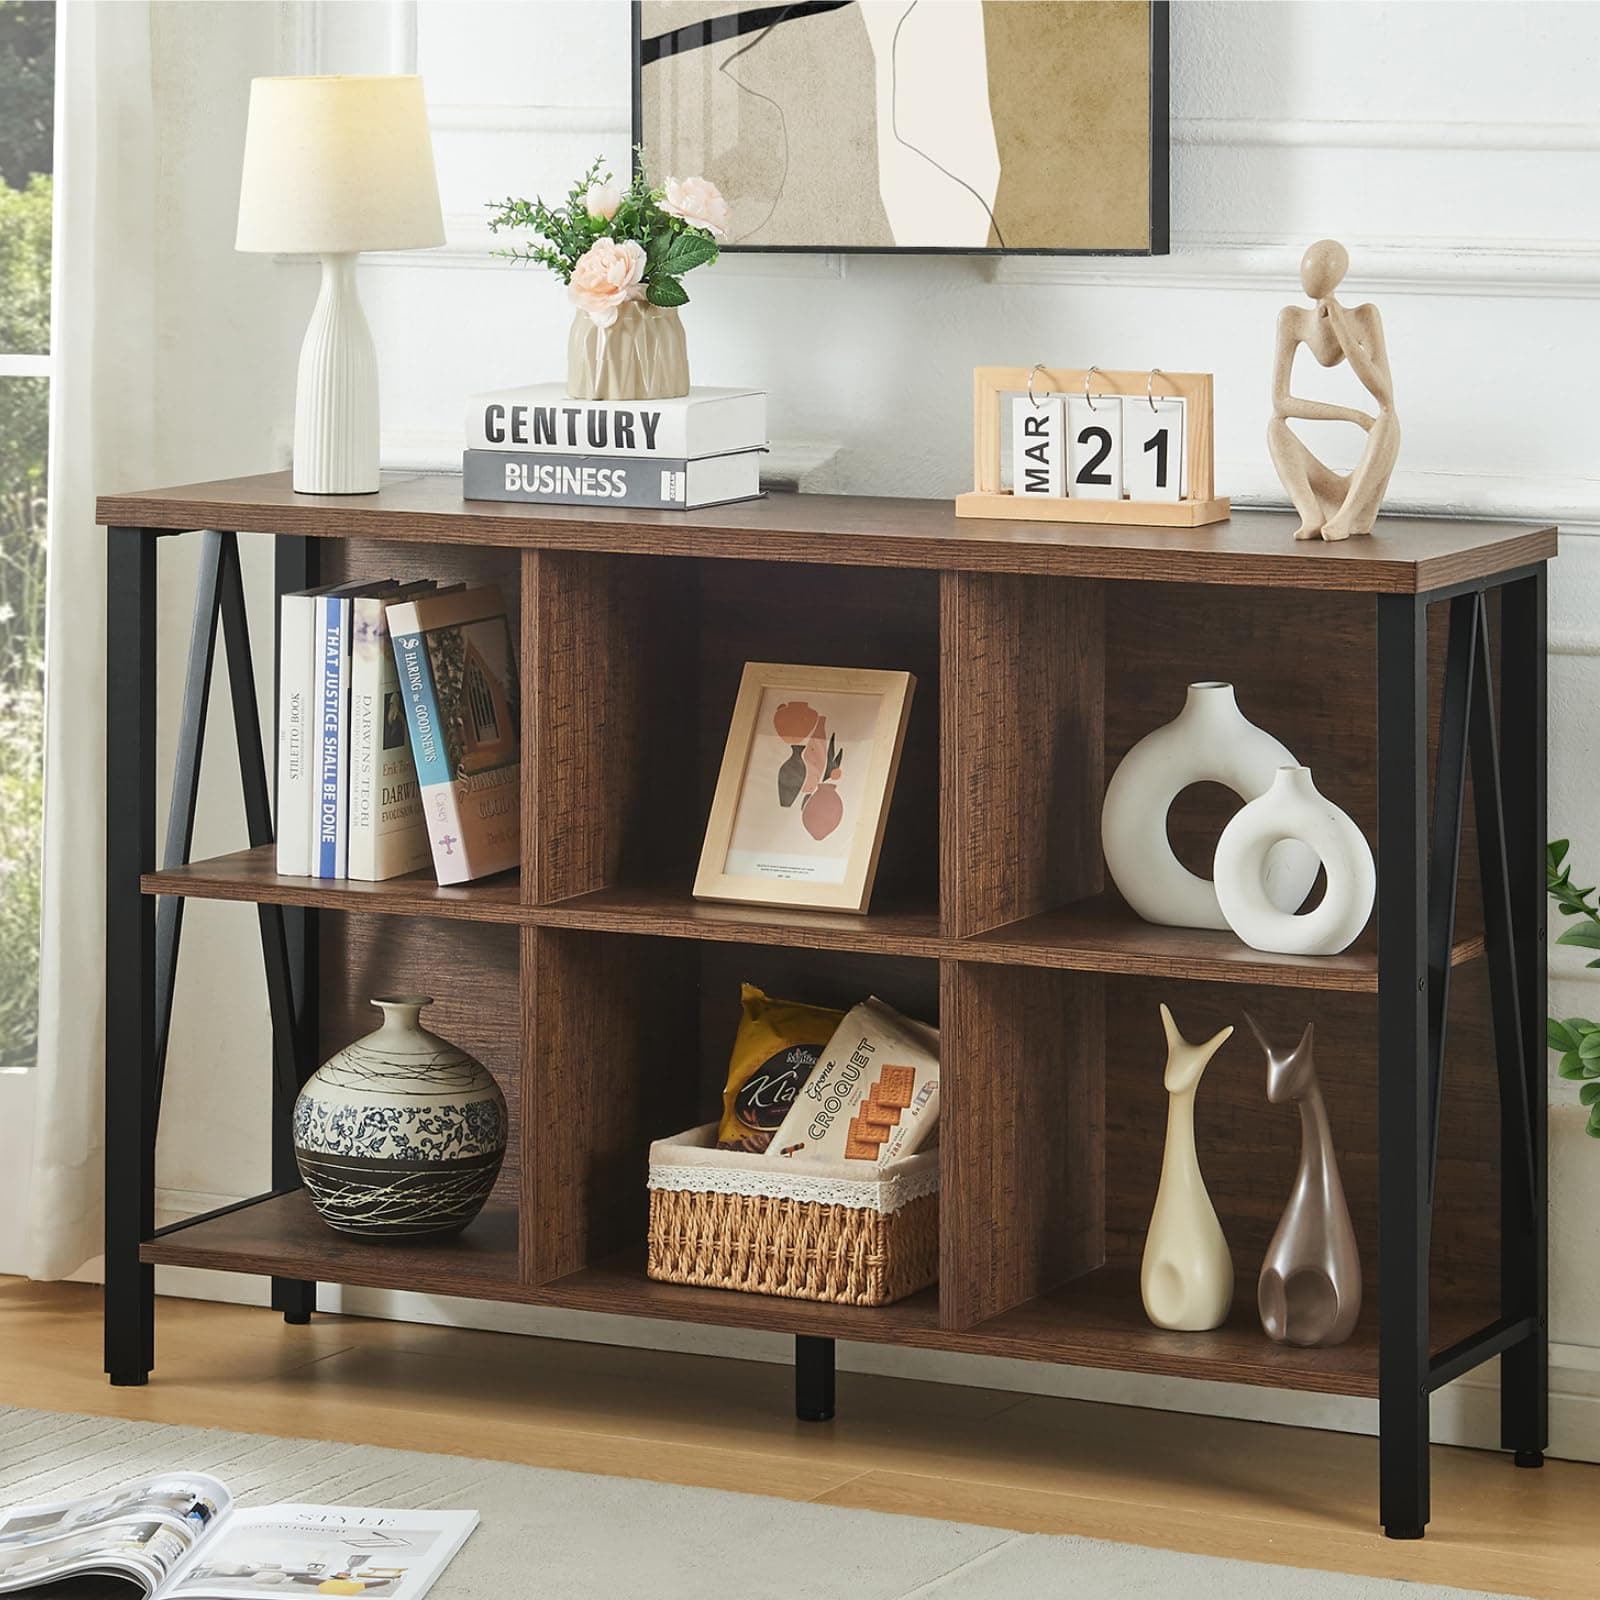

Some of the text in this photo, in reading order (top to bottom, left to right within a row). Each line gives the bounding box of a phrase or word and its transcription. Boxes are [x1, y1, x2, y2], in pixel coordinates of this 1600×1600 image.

[485, 404, 661, 450] CENTURY
[1025, 415, 1050, 493] MAR
[504, 463, 627, 498] BUSINESS
[1076, 426, 1169, 488] 2 1
[289, 692, 300, 780] STILETTO BOOK
[321, 627, 340, 843] THAT JUSTICE SHALL BE DONE
[415, 704, 431, 734] GOOD
[360, 695, 372, 829] DARWINS TEORI
[421, 731, 438, 763] NEWS
[381, 781, 420, 806] DARWI
[741, 1070, 798, 1108] Kla
[807, 1037, 876, 1141] CROQUET
